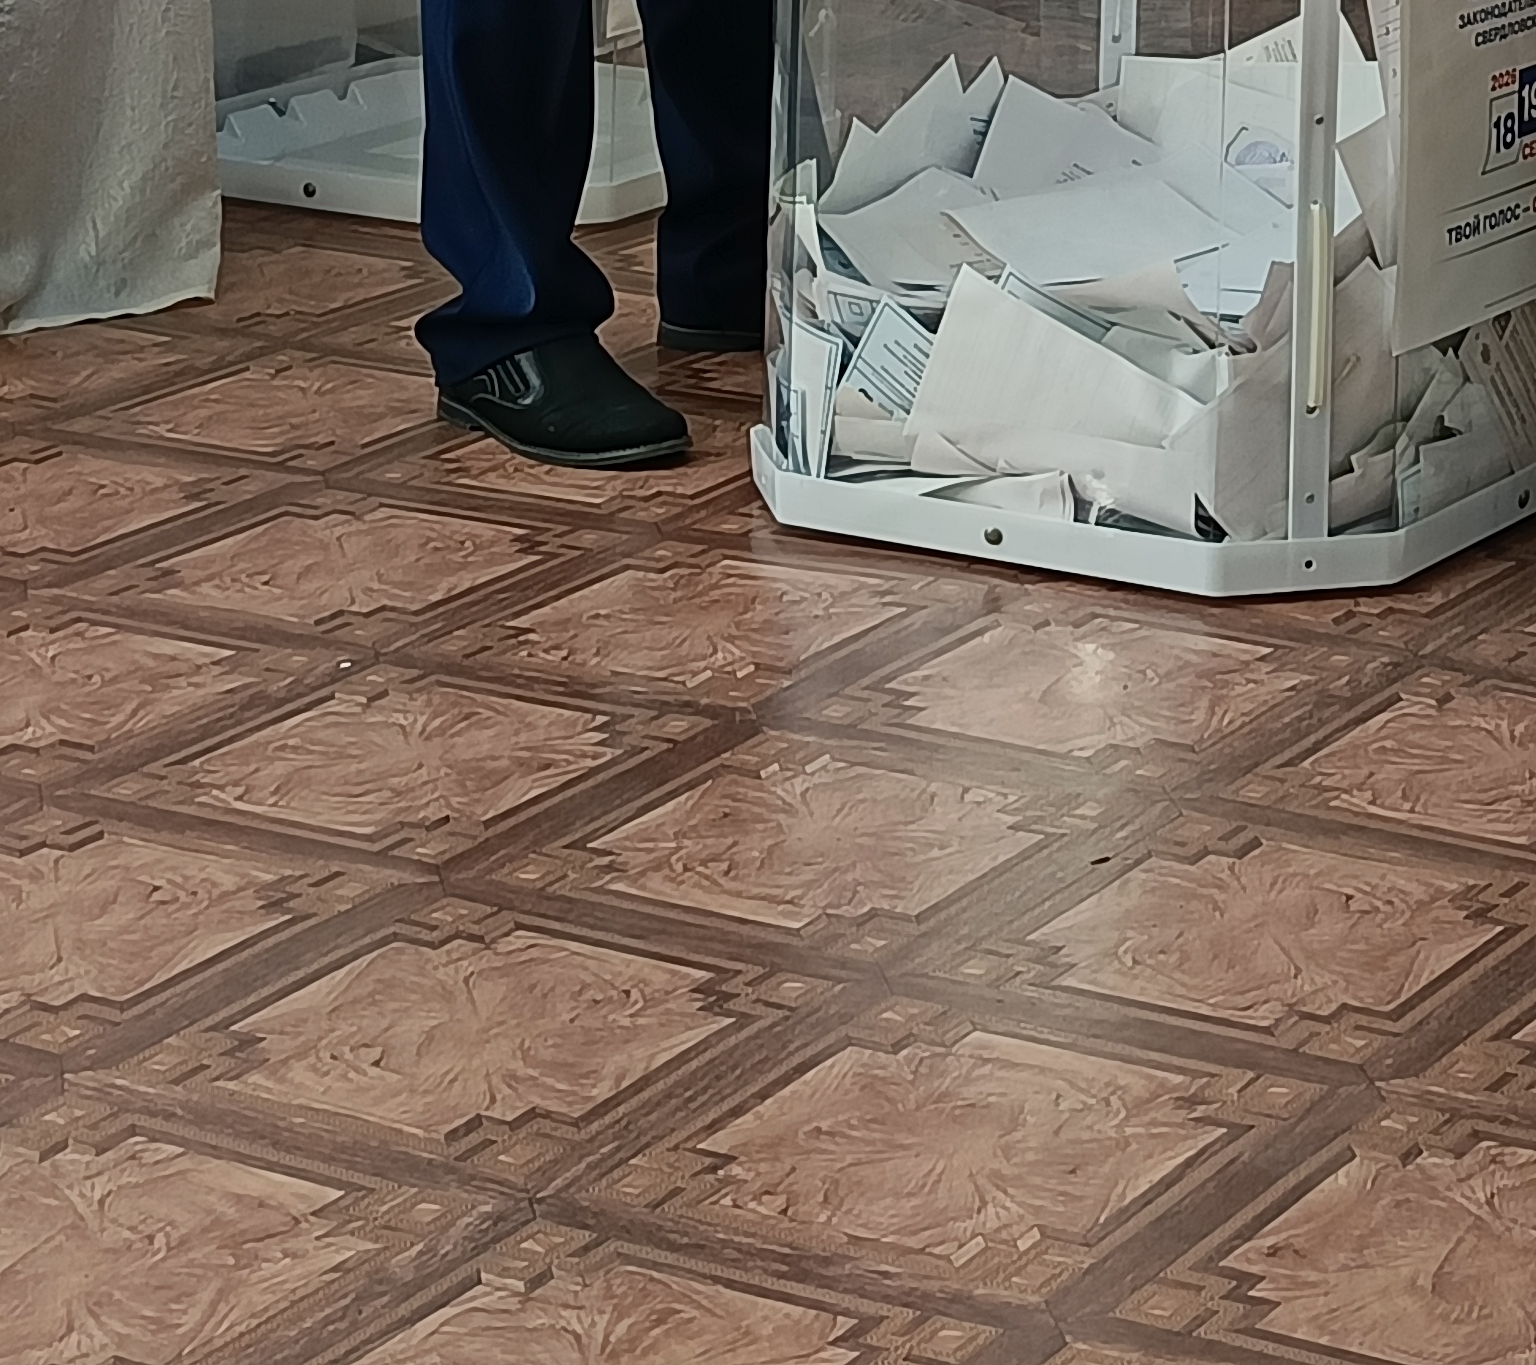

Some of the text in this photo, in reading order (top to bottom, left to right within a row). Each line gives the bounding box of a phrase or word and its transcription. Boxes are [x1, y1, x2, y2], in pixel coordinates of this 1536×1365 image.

[1493, 112, 1516, 154] 18
[1446, 213, 1481, 246] ТВОЙ
[1482, 202, 1521, 234] ГОЛОС
